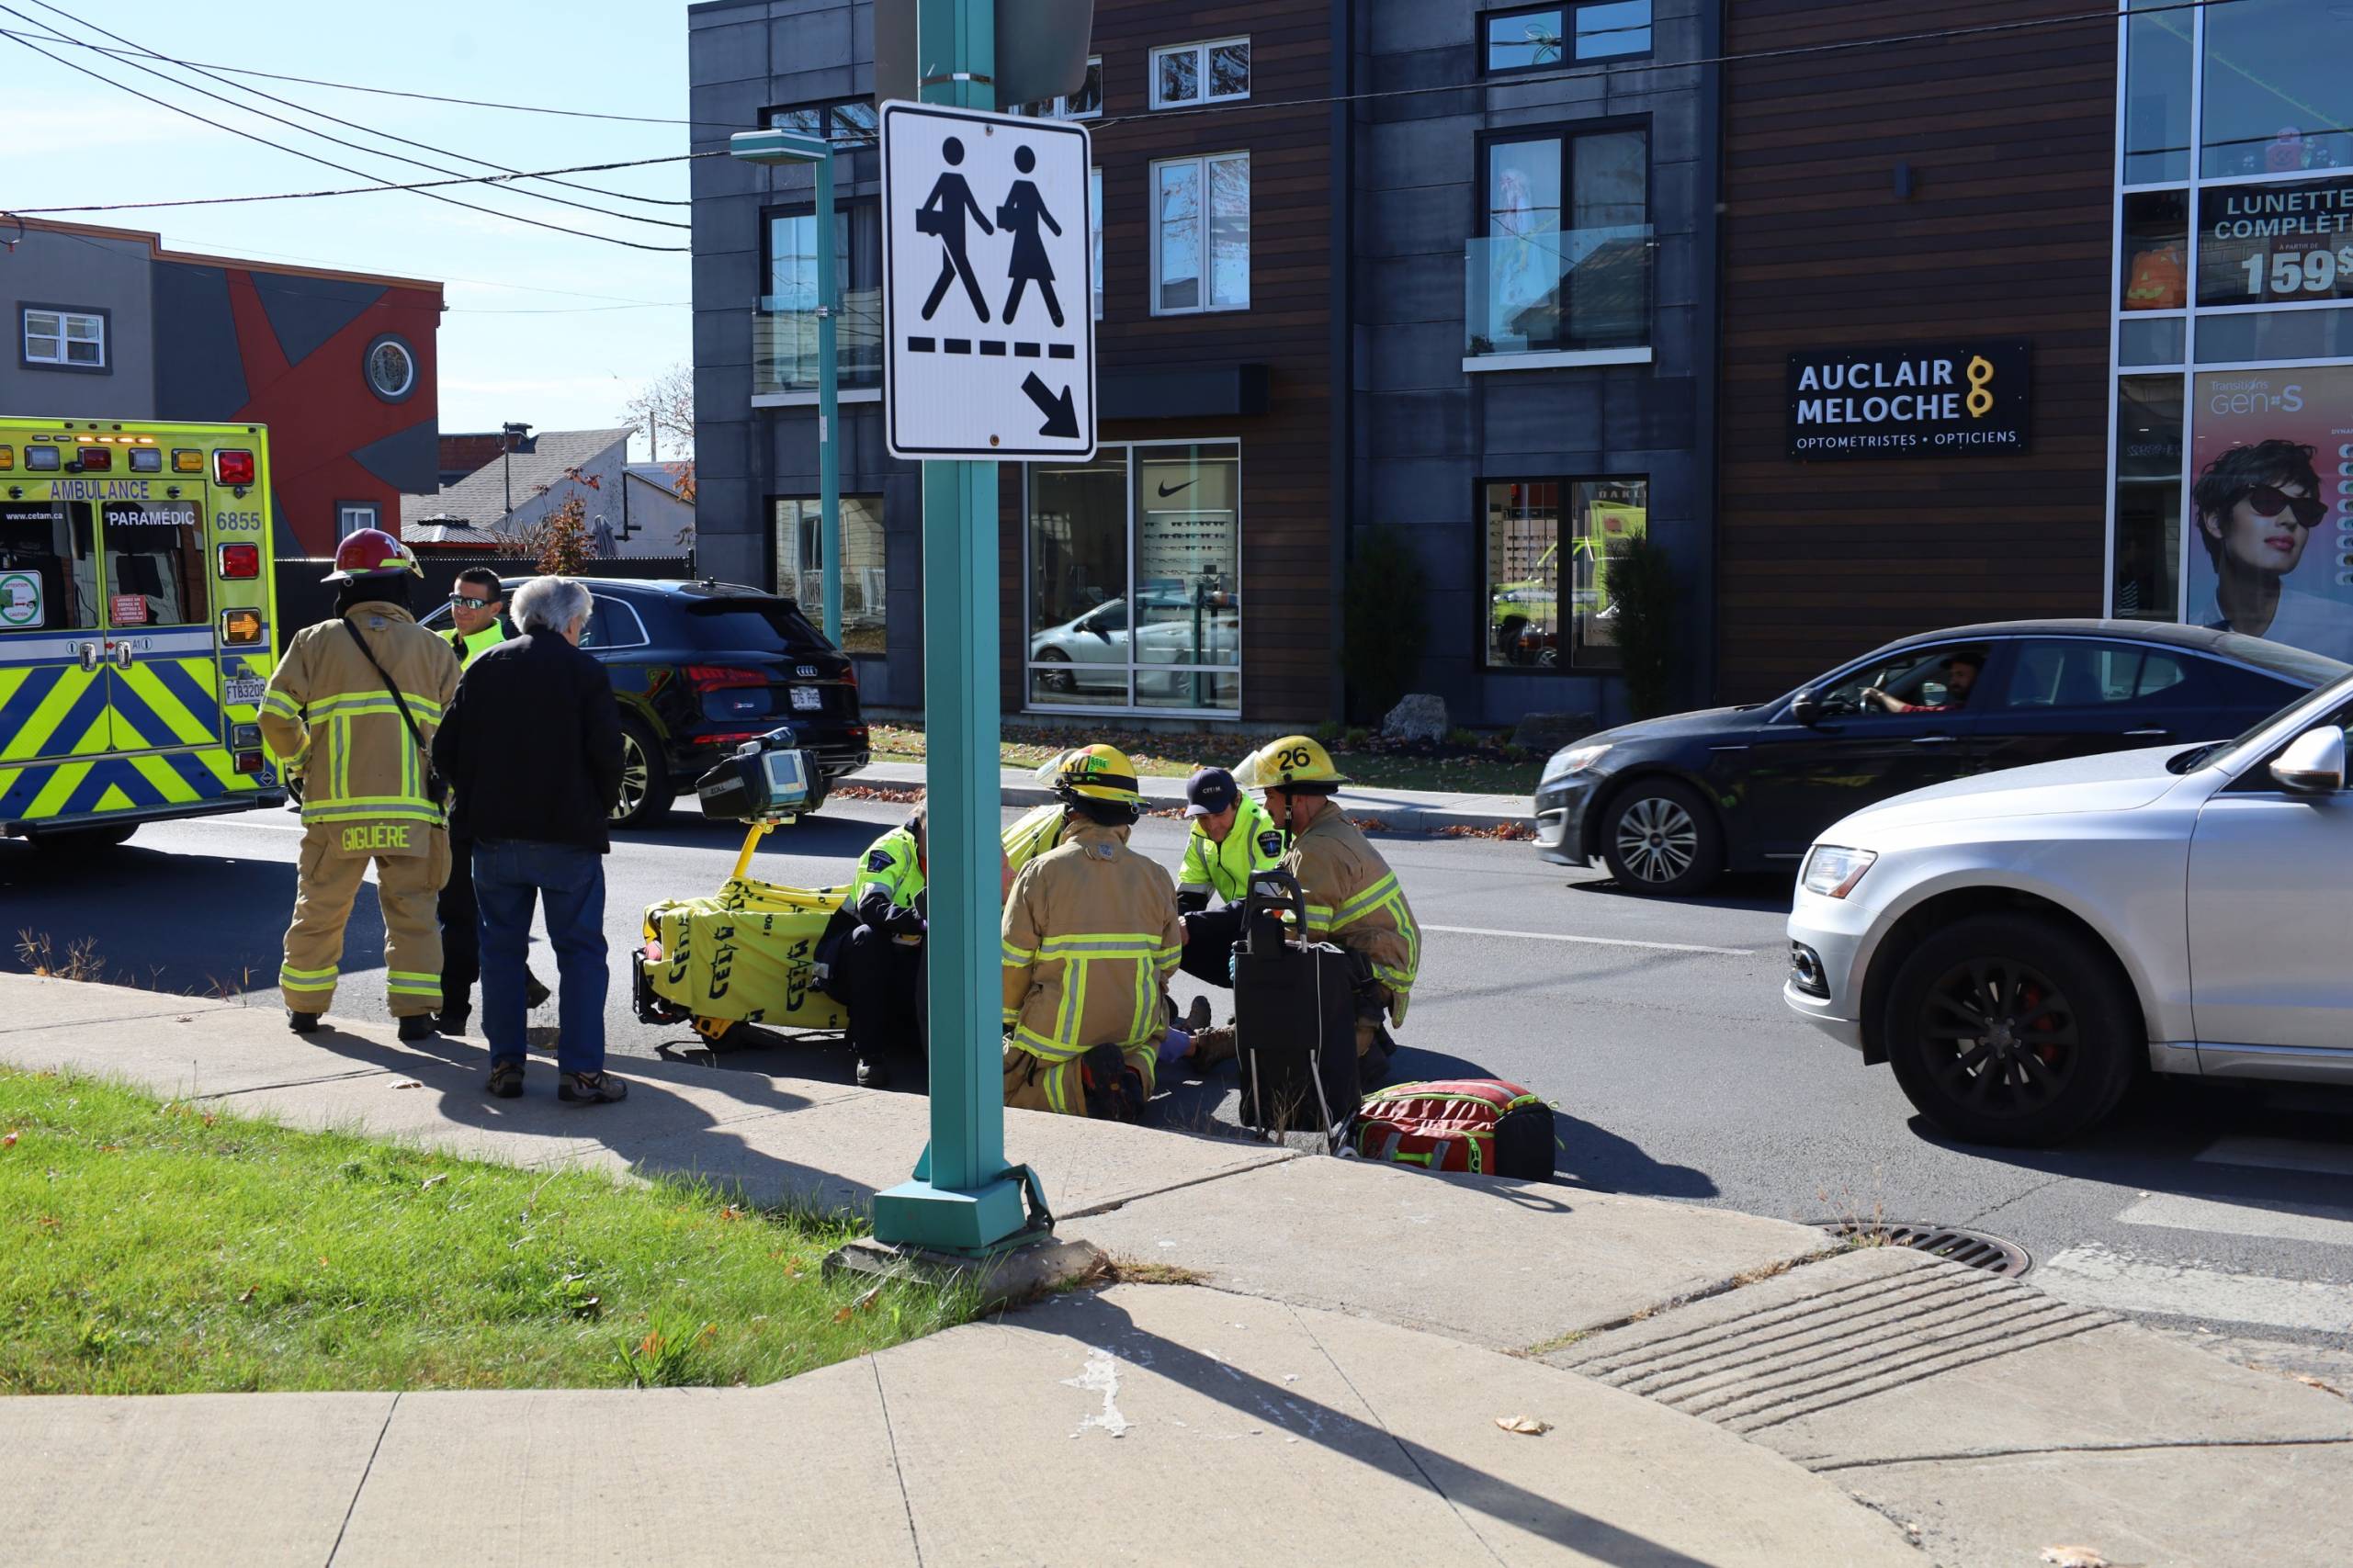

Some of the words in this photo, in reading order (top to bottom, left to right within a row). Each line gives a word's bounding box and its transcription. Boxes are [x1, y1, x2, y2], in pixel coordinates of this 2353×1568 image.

[2227, 189, 2353, 215] LUNETTE
[2215, 210, 2353, 240] COMPLÈT
[1798, 359, 1954, 390] AUCLAIR
[1797, 393, 1961, 424] MELOCHE
[1934, 430, 2017, 445] OPTICIENS
[51, 480, 150, 500] AMBULANCE
[109, 508, 195, 525] PARAMÉDIC
[216, 512, 261, 531] 6855
[1277, 747, 1310, 771] 26
